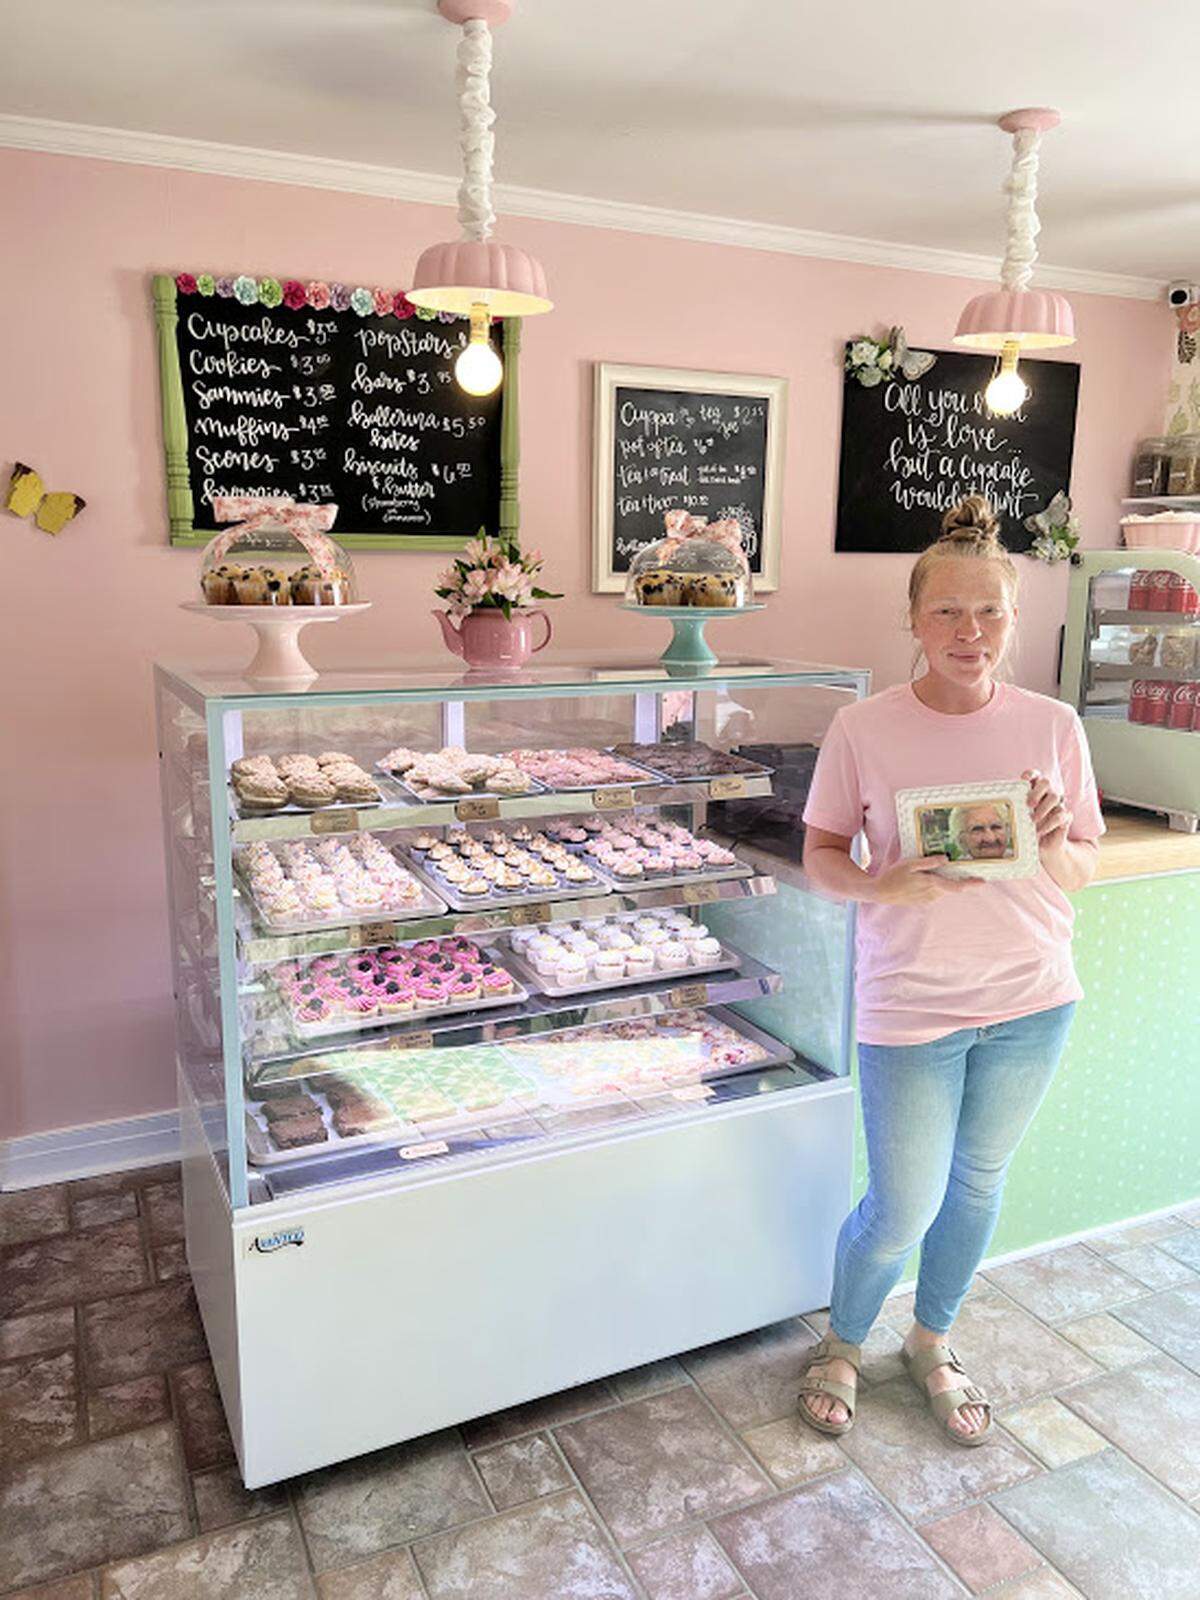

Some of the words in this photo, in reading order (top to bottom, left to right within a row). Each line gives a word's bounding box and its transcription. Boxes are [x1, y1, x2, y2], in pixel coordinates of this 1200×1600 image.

[187, 312, 310, 350] Cupcakes
[189, 349, 282, 378] Cookies
[351, 362, 407, 394] bars
[191, 380, 290, 409] Sammies
[884, 382, 922, 416] All
[922, 388, 969, 427] you
[347, 399, 440, 431] ballerina
[369, 428, 420, 451] bites
[907, 417, 937, 448] is
[195, 445, 279, 475] Scones
[343, 447, 418, 480] biscuits
[883, 437, 941, 481] but
[939, 455, 956, 477] a
[382, 476, 435, 498] butter
